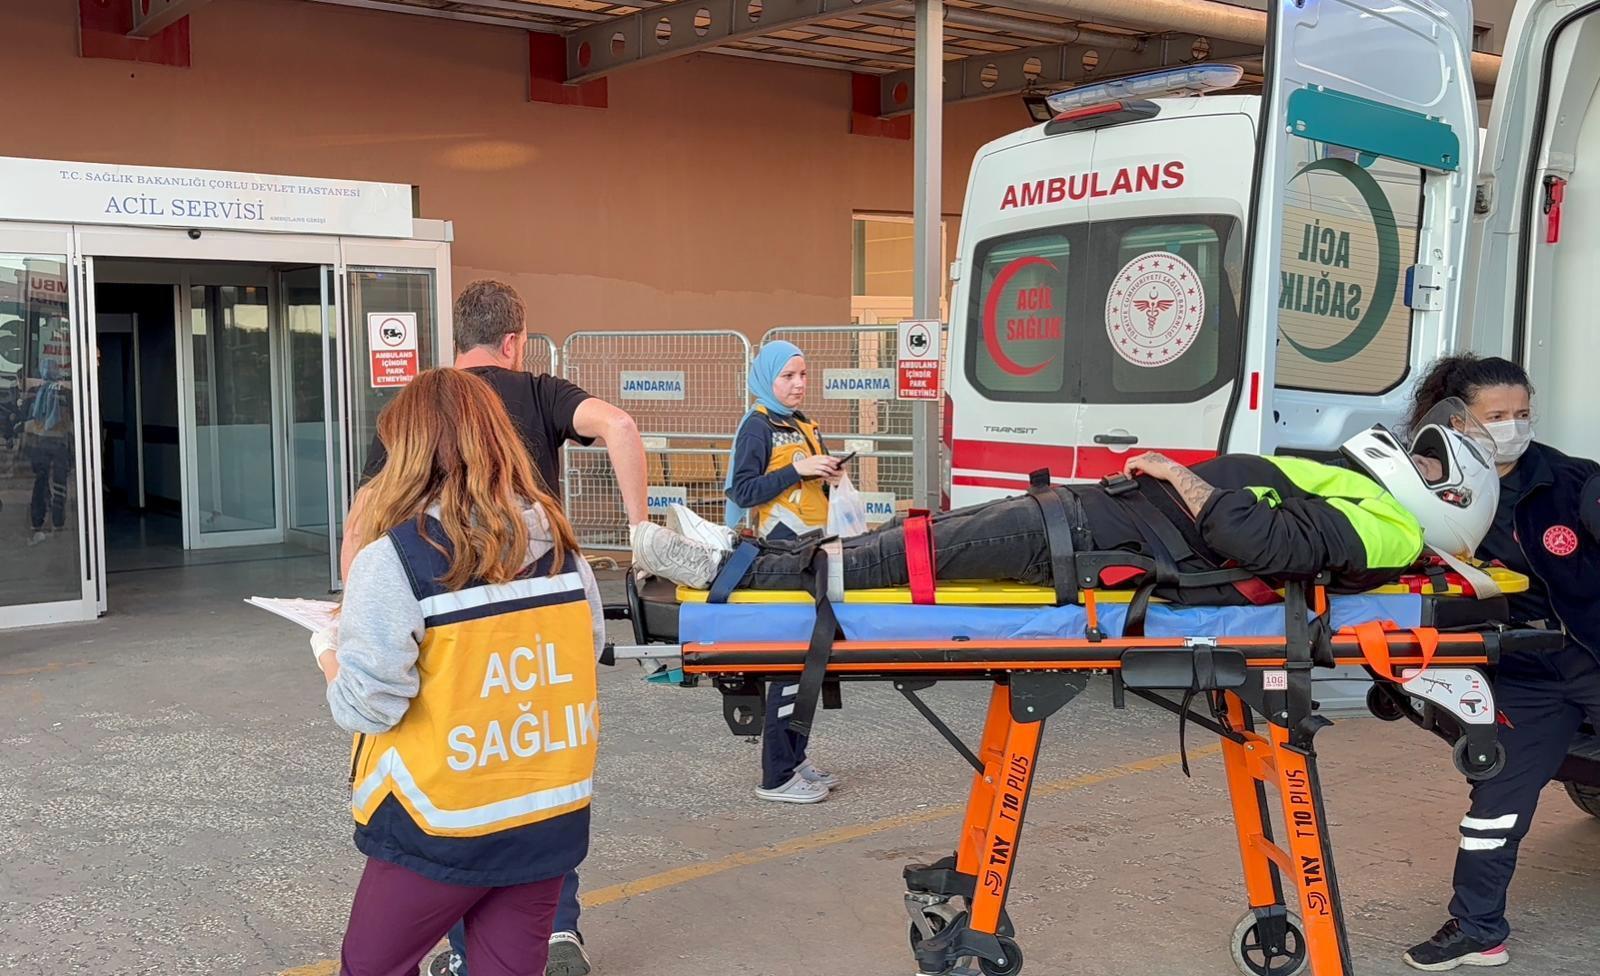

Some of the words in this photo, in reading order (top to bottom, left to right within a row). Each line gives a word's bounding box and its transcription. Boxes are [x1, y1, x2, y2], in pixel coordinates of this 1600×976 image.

[60, 170, 82, 181] T.C.
[85, 171, 133, 184] SAĞLIK
[137, 175, 206, 188] BAKANLIĞI
[209, 180, 248, 190] ÇORLU
[251, 182, 295, 194] DEVLET
[299, 185, 361, 198] HASTANESİ
[999, 160, 1185, 210] AMBULANS
[105, 193, 164, 215] ACİL
[171, 198, 265, 221] SERVİSİ
[1017, 283, 1054, 311] ACİL
[1007, 313, 1063, 341] SAĞLIK
[900, 361, 938, 369] AMBULANS
[623, 380, 682, 391] JANDARMA
[825, 378, 891, 389] JANDARMA
[909, 380, 927, 388] PARK
[984, 425, 1038, 434] TRANSIT
[480, 632, 574, 698] ACİL
[447, 700, 598, 771] SAĞLIK
[990, 835, 1011, 865] TAY
[1007, 753, 1029, 791] PLUS
[1301, 855, 1323, 887] TAY
